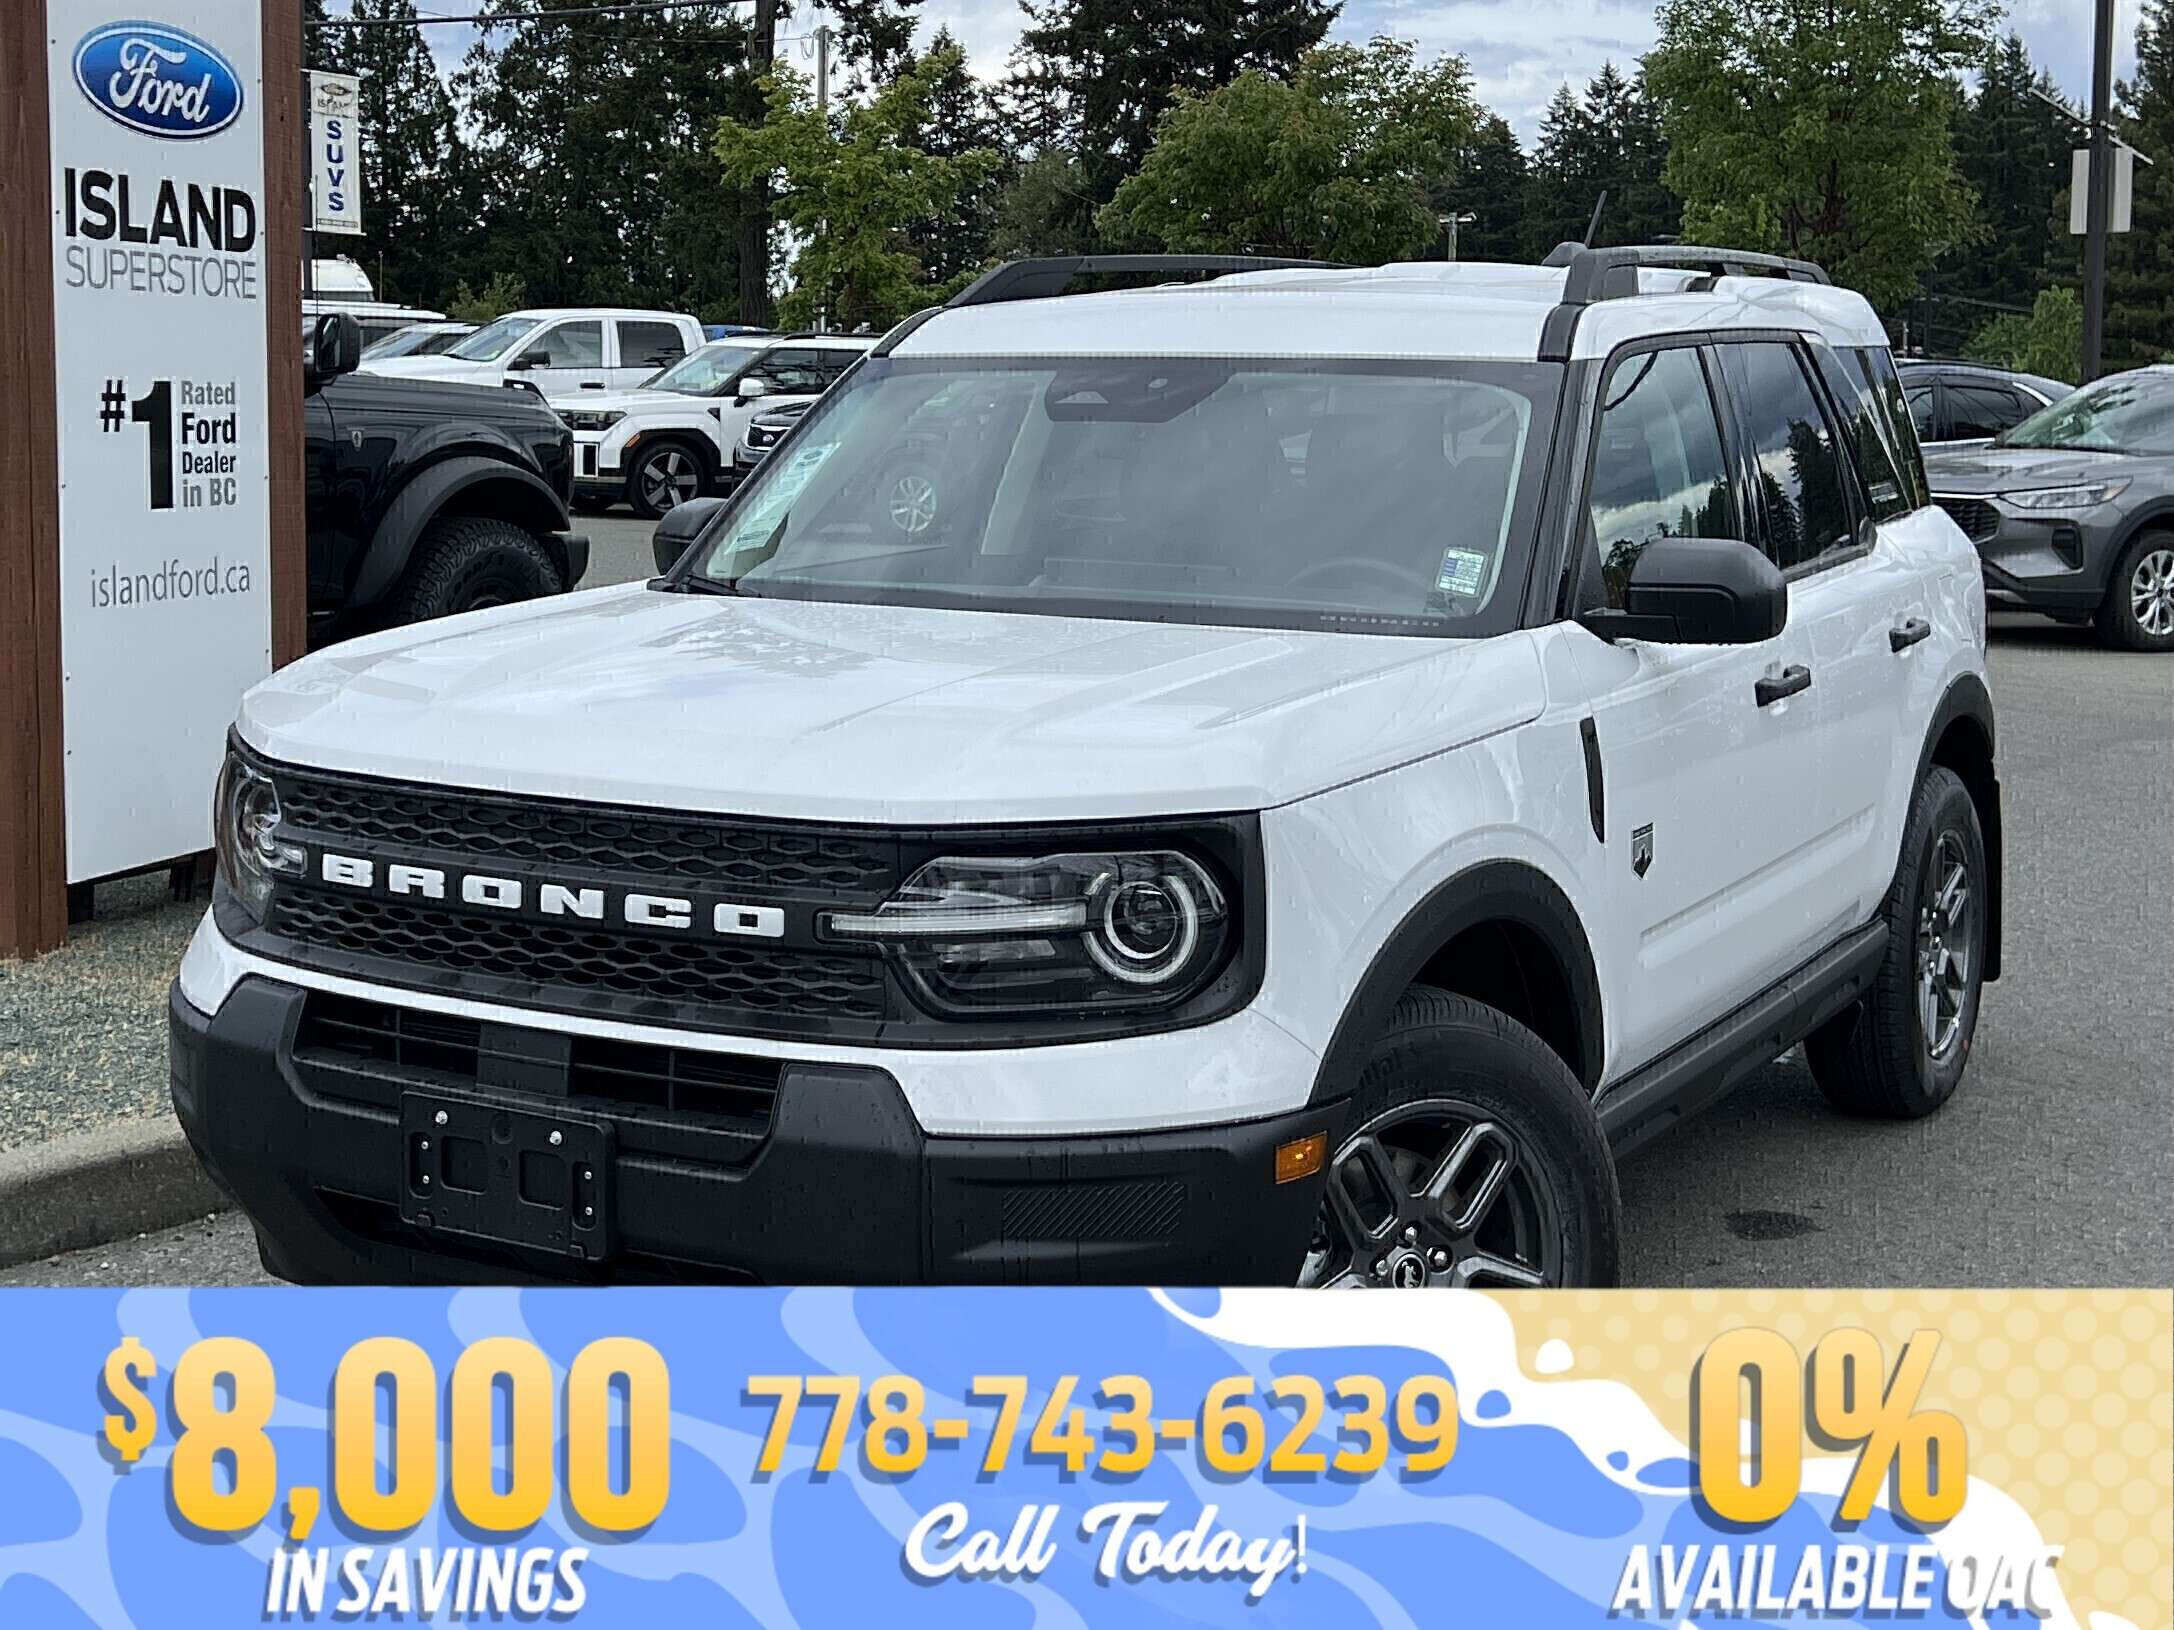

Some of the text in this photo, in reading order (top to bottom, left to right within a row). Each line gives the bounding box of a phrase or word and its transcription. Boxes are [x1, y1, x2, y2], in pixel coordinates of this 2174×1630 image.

[109, 38, 212, 123] Ford
[64, 167, 256, 252] ISLAND
[65, 245, 257, 300] SUPERSTORE
[181, 381, 236, 405] Rated
[99, 379, 174, 509] #1
[181, 412, 237, 444] Ford
[182, 451, 237, 475] Dealer
[183, 478, 237, 507] in BC
[91, 556, 251, 608] islandford.ca
[322, 853, 785, 938] BRONCO
